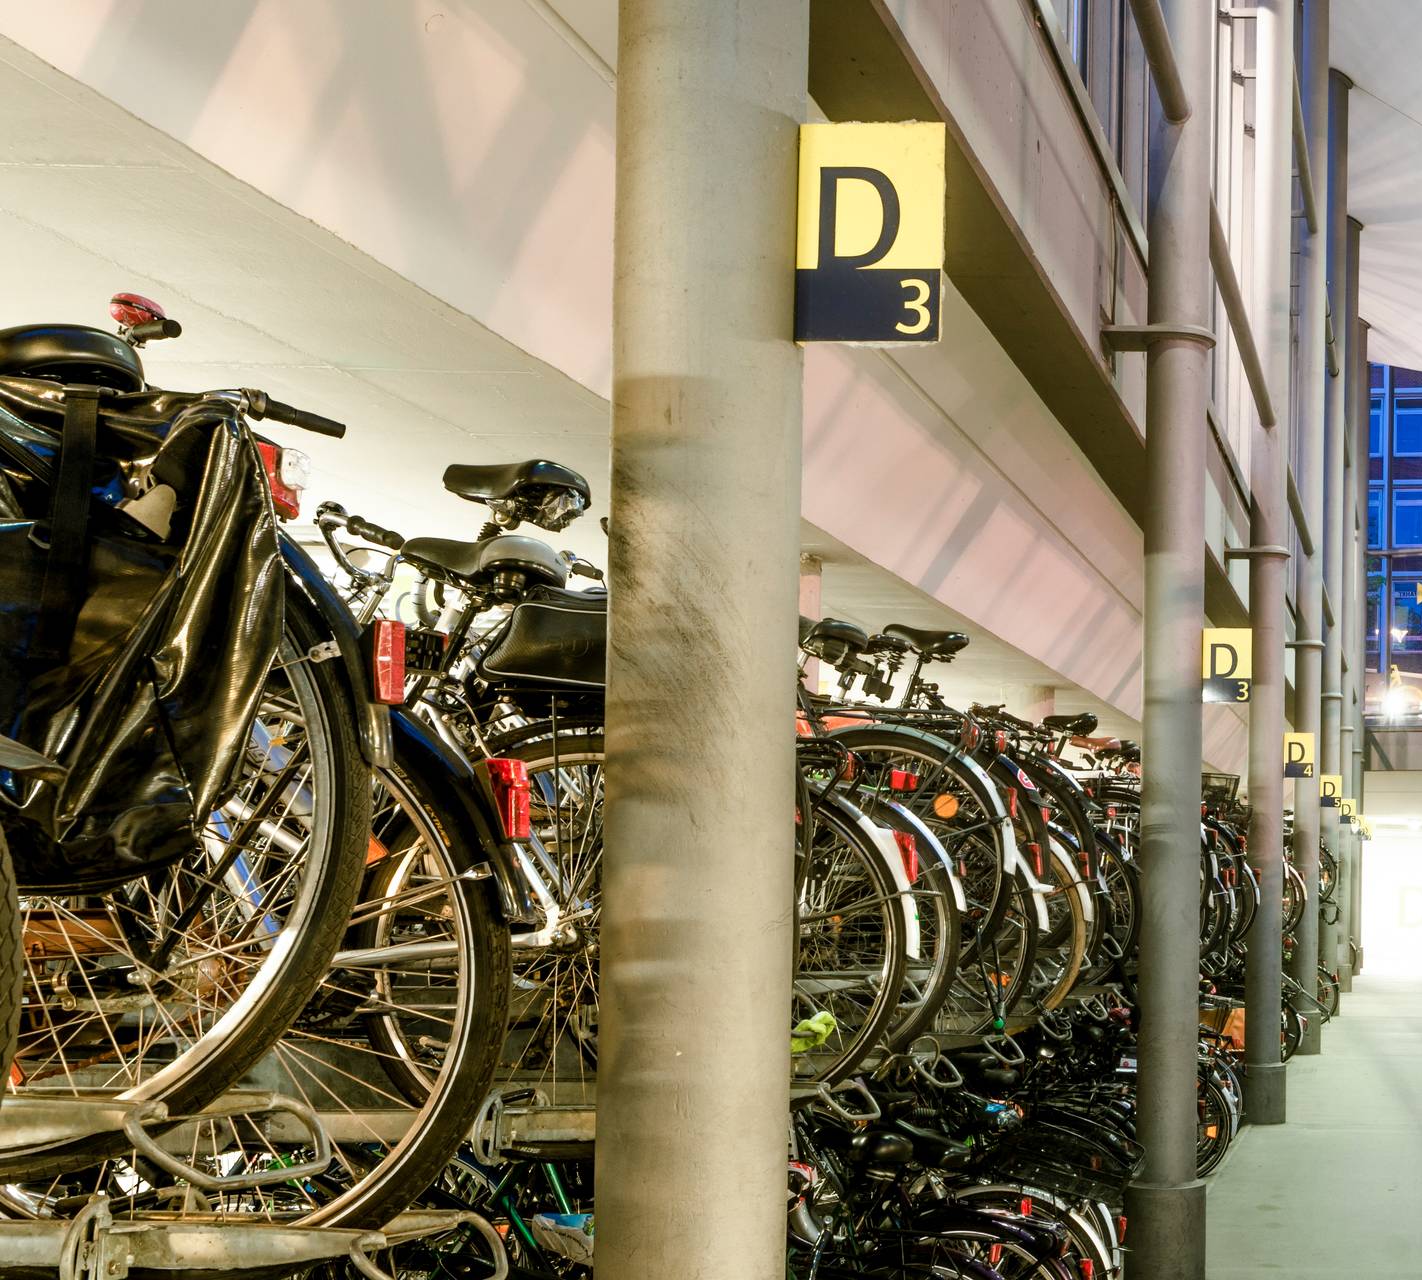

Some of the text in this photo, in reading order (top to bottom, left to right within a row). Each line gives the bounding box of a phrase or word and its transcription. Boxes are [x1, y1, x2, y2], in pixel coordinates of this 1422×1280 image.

[817, 167, 900, 269] D
[895, 279, 931, 335] 3
[1210, 643, 1238, 679] D
[1236, 681, 1249, 701] 3
[1288, 742, 1305, 763] D
[1304, 765, 1313, 776] 4
[1323, 781, 1335, 797] D
[1334, 798, 1341, 807] 5
[1341, 803, 1352, 817] D
